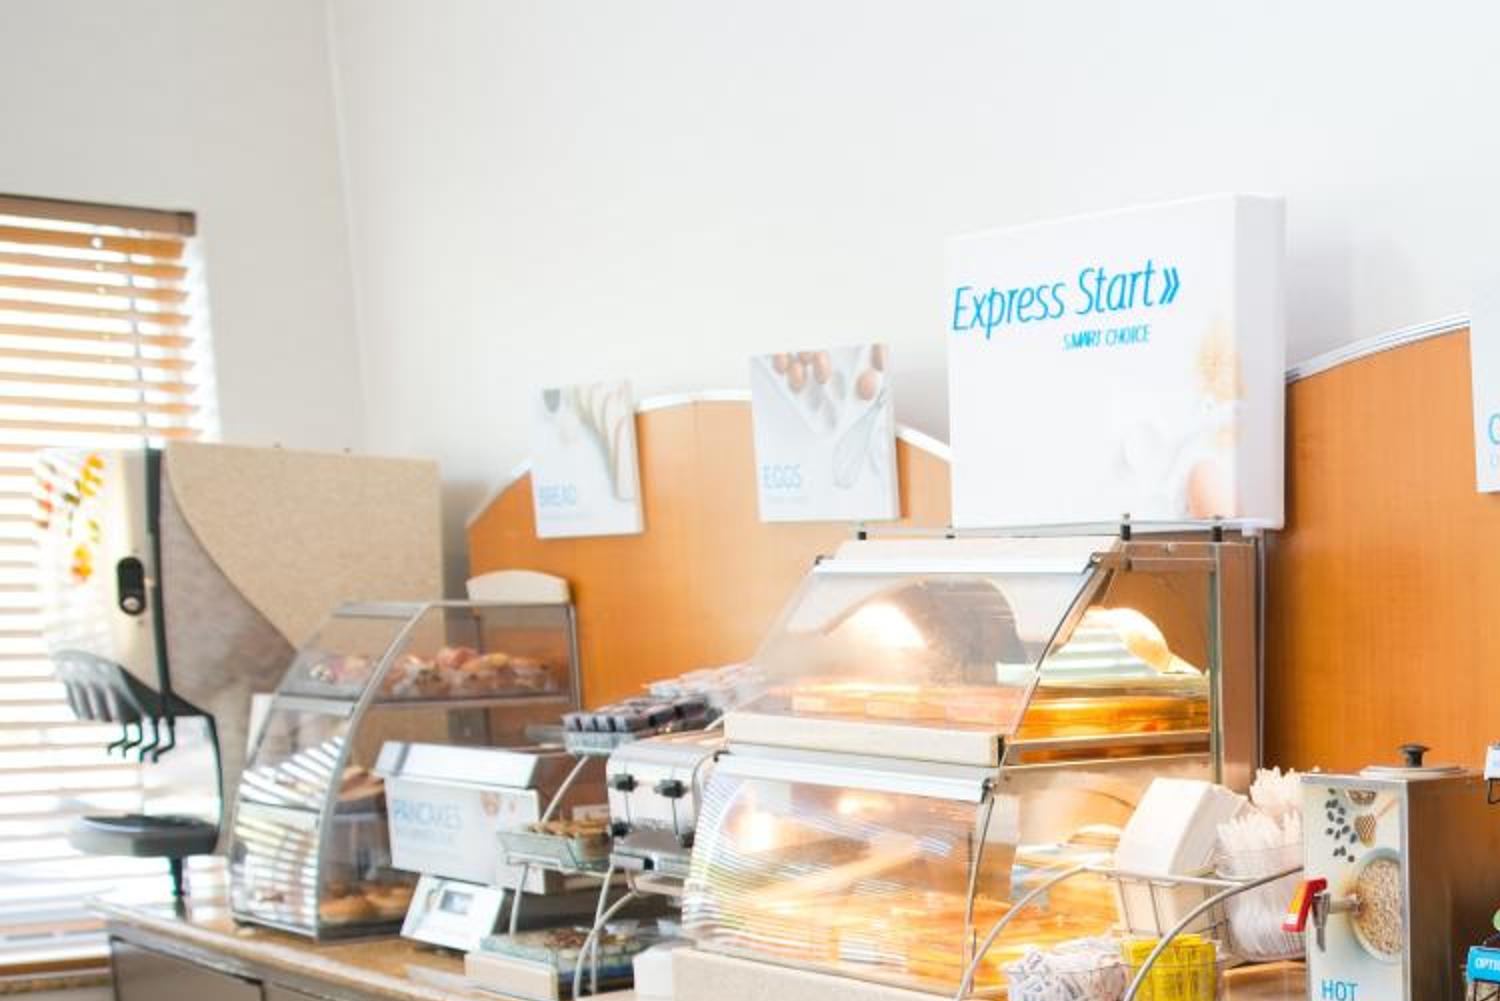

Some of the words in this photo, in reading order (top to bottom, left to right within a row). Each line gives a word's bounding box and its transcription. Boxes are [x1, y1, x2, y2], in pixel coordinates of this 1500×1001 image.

[952, 282, 1067, 340] Express
[1075, 259, 1156, 315] Start
[1063, 330, 1101, 350] SMART
[1105, 324, 1150, 345] CHOICE
